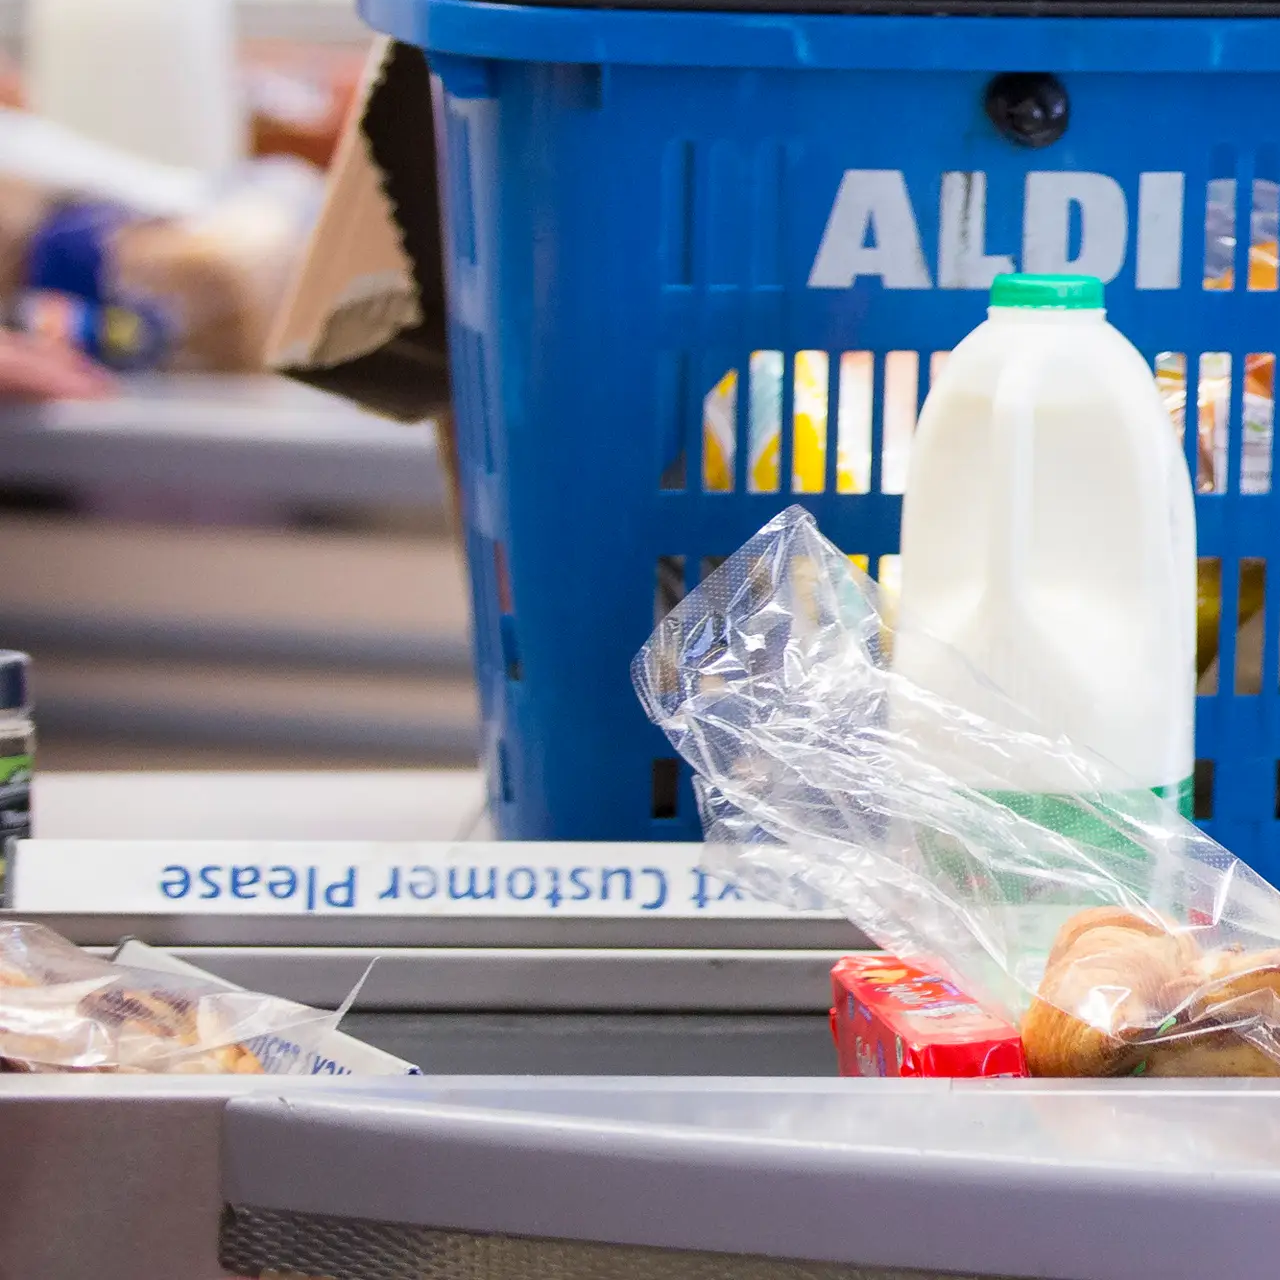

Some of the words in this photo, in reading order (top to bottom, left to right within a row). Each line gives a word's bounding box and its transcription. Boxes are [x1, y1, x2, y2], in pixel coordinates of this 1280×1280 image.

[806, 169, 1185, 290] ALDI
[159, 864, 357, 912] Please
[378, 865, 669, 911] Customer
